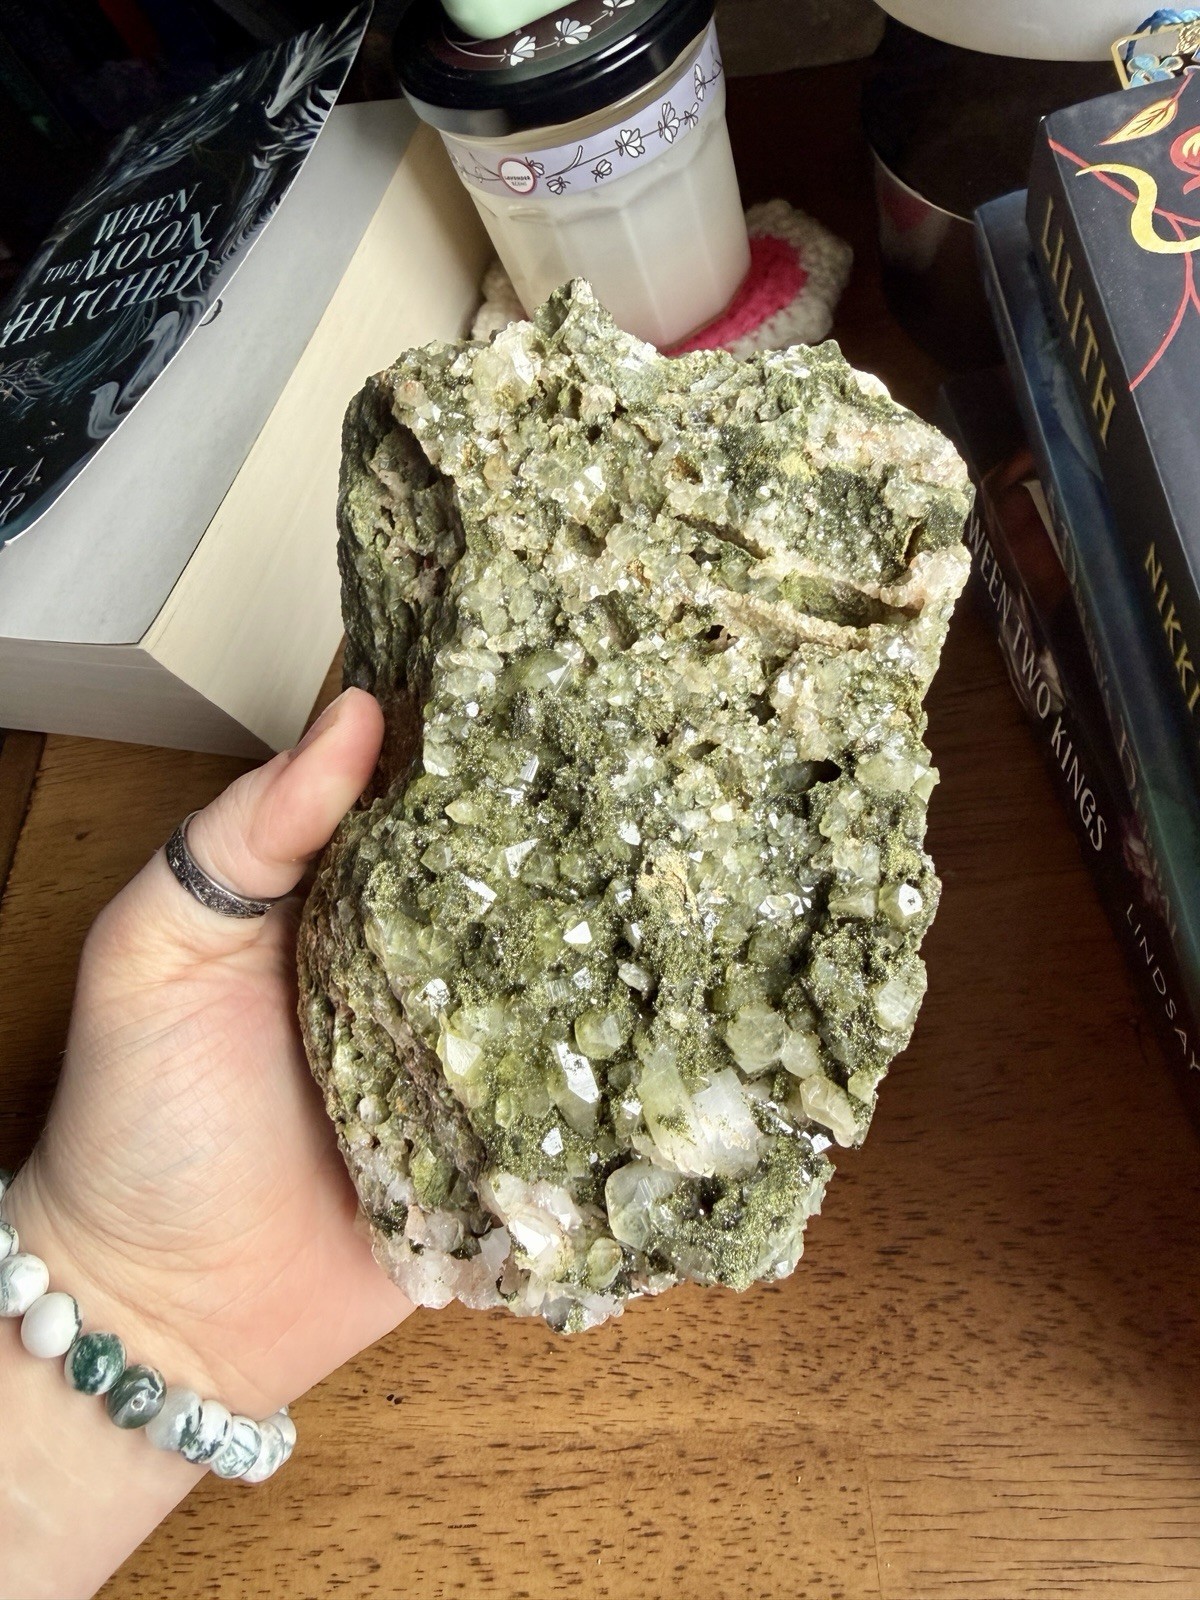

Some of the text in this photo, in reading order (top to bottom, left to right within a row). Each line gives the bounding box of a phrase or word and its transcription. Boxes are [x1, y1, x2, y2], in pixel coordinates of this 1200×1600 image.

[43, 204, 222, 286] THE MOON
[94, 182, 202, 245] WHEN
[0, 249, 209, 348] HATCHED
[1041, 195, 1116, 450] LILITH
[968, 506, 1107, 851] WEEN TWO KINGS
[1144, 542, 1200, 717] NIKKI
[1127, 903, 1200, 1071] LINDSAY
